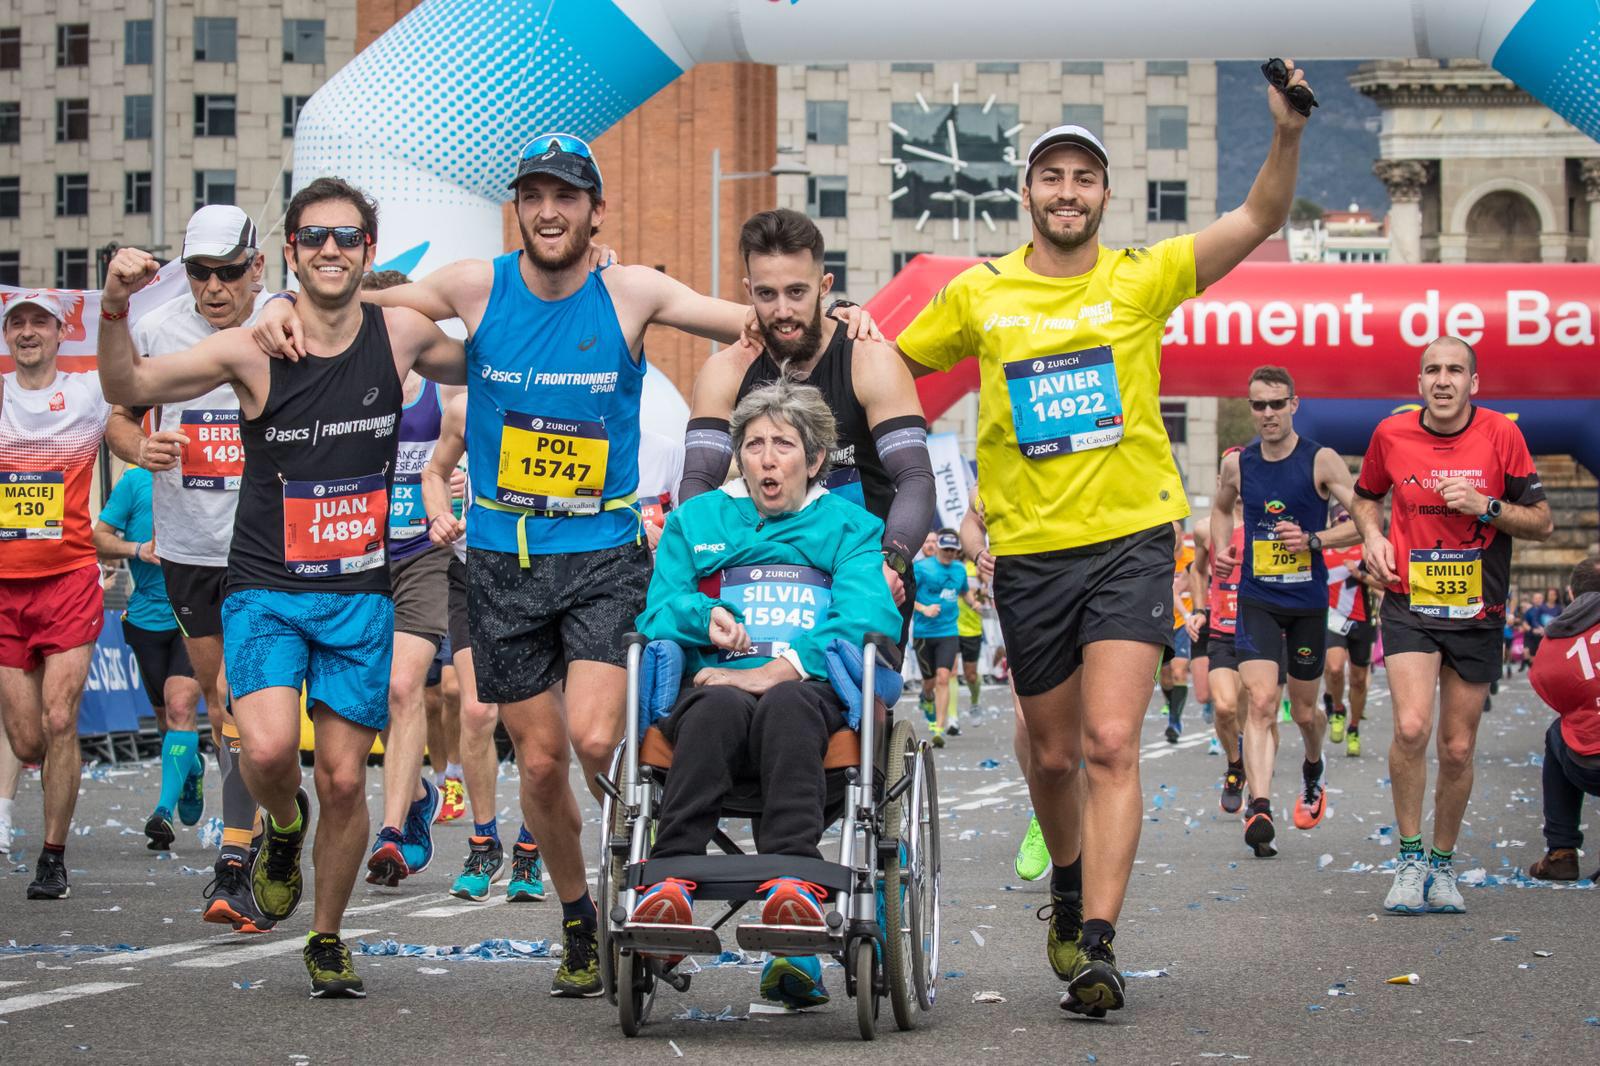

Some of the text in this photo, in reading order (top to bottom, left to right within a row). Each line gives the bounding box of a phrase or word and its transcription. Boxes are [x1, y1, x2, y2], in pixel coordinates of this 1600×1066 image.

[1161, 290, 1595, 347] ament de Ba
[1047, 357, 1080, 369] ZURICH
[534, 371, 619, 386] FRONTRUNNER
[590, 383, 616, 394] SPAIN
[1028, 370, 1103, 403] JAVIER
[1033, 392, 1107, 423] 14922
[321, 413, 397, 437] FRONTRUNNER
[374, 425, 395, 439] SPAIN
[546, 422, 578, 433] ZURICH
[536, 436, 578, 457] POL
[521, 456, 592, 482] 15747
[1450, 469, 1483, 477] ESPORTIU
[5, 486, 54, 501] MACIEJ
[328, 483, 359, 494] ZURICH
[14, 502, 45, 516] 130
[312, 497, 368, 524] JUAN
[561, 501, 597, 509] CaixaBank
[308, 517, 377, 544] 14894
[1272, 554, 1297, 566] 705
[765, 570, 799, 578] ZURICH
[1426, 564, 1474, 577] EMILIO
[1435, 580, 1468, 595] 333
[743, 585, 816, 606] SILVIA
[742, 607, 816, 630] 15945
